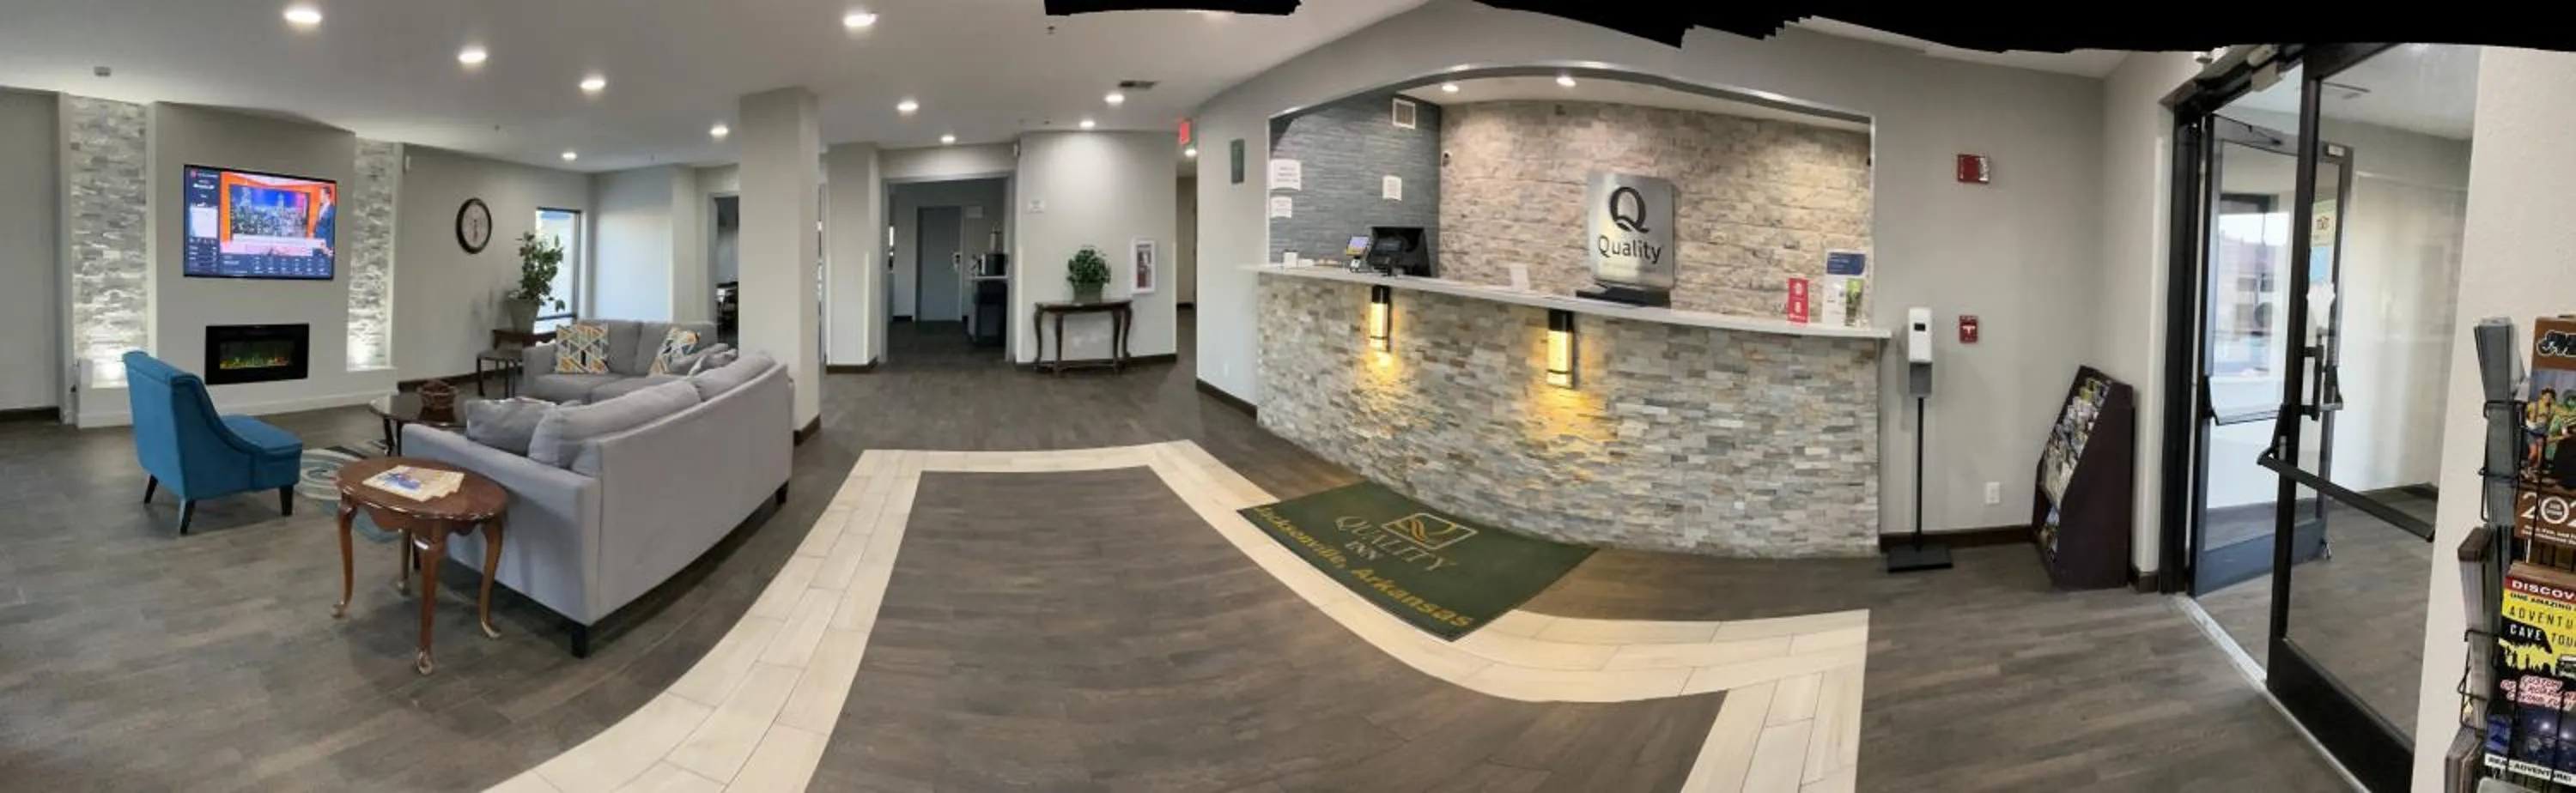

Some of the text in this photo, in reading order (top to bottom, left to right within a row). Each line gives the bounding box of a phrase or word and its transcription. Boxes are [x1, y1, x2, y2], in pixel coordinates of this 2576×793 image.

[1609, 186, 1650, 233] Q
[1598, 234, 1662, 265] Quality
[1334, 516, 1458, 572] QUALITY
[1344, 540, 1385, 560] INN
[1351, 568, 1475, 627] Arkansas
[2512, 579, 2575, 600] DISCOV
[2509, 605, 2573, 629] ADVENTU
[2510, 623, 2576, 647] CAVE TOU
[2513, 762, 2573, 782] ADVENTRE!
